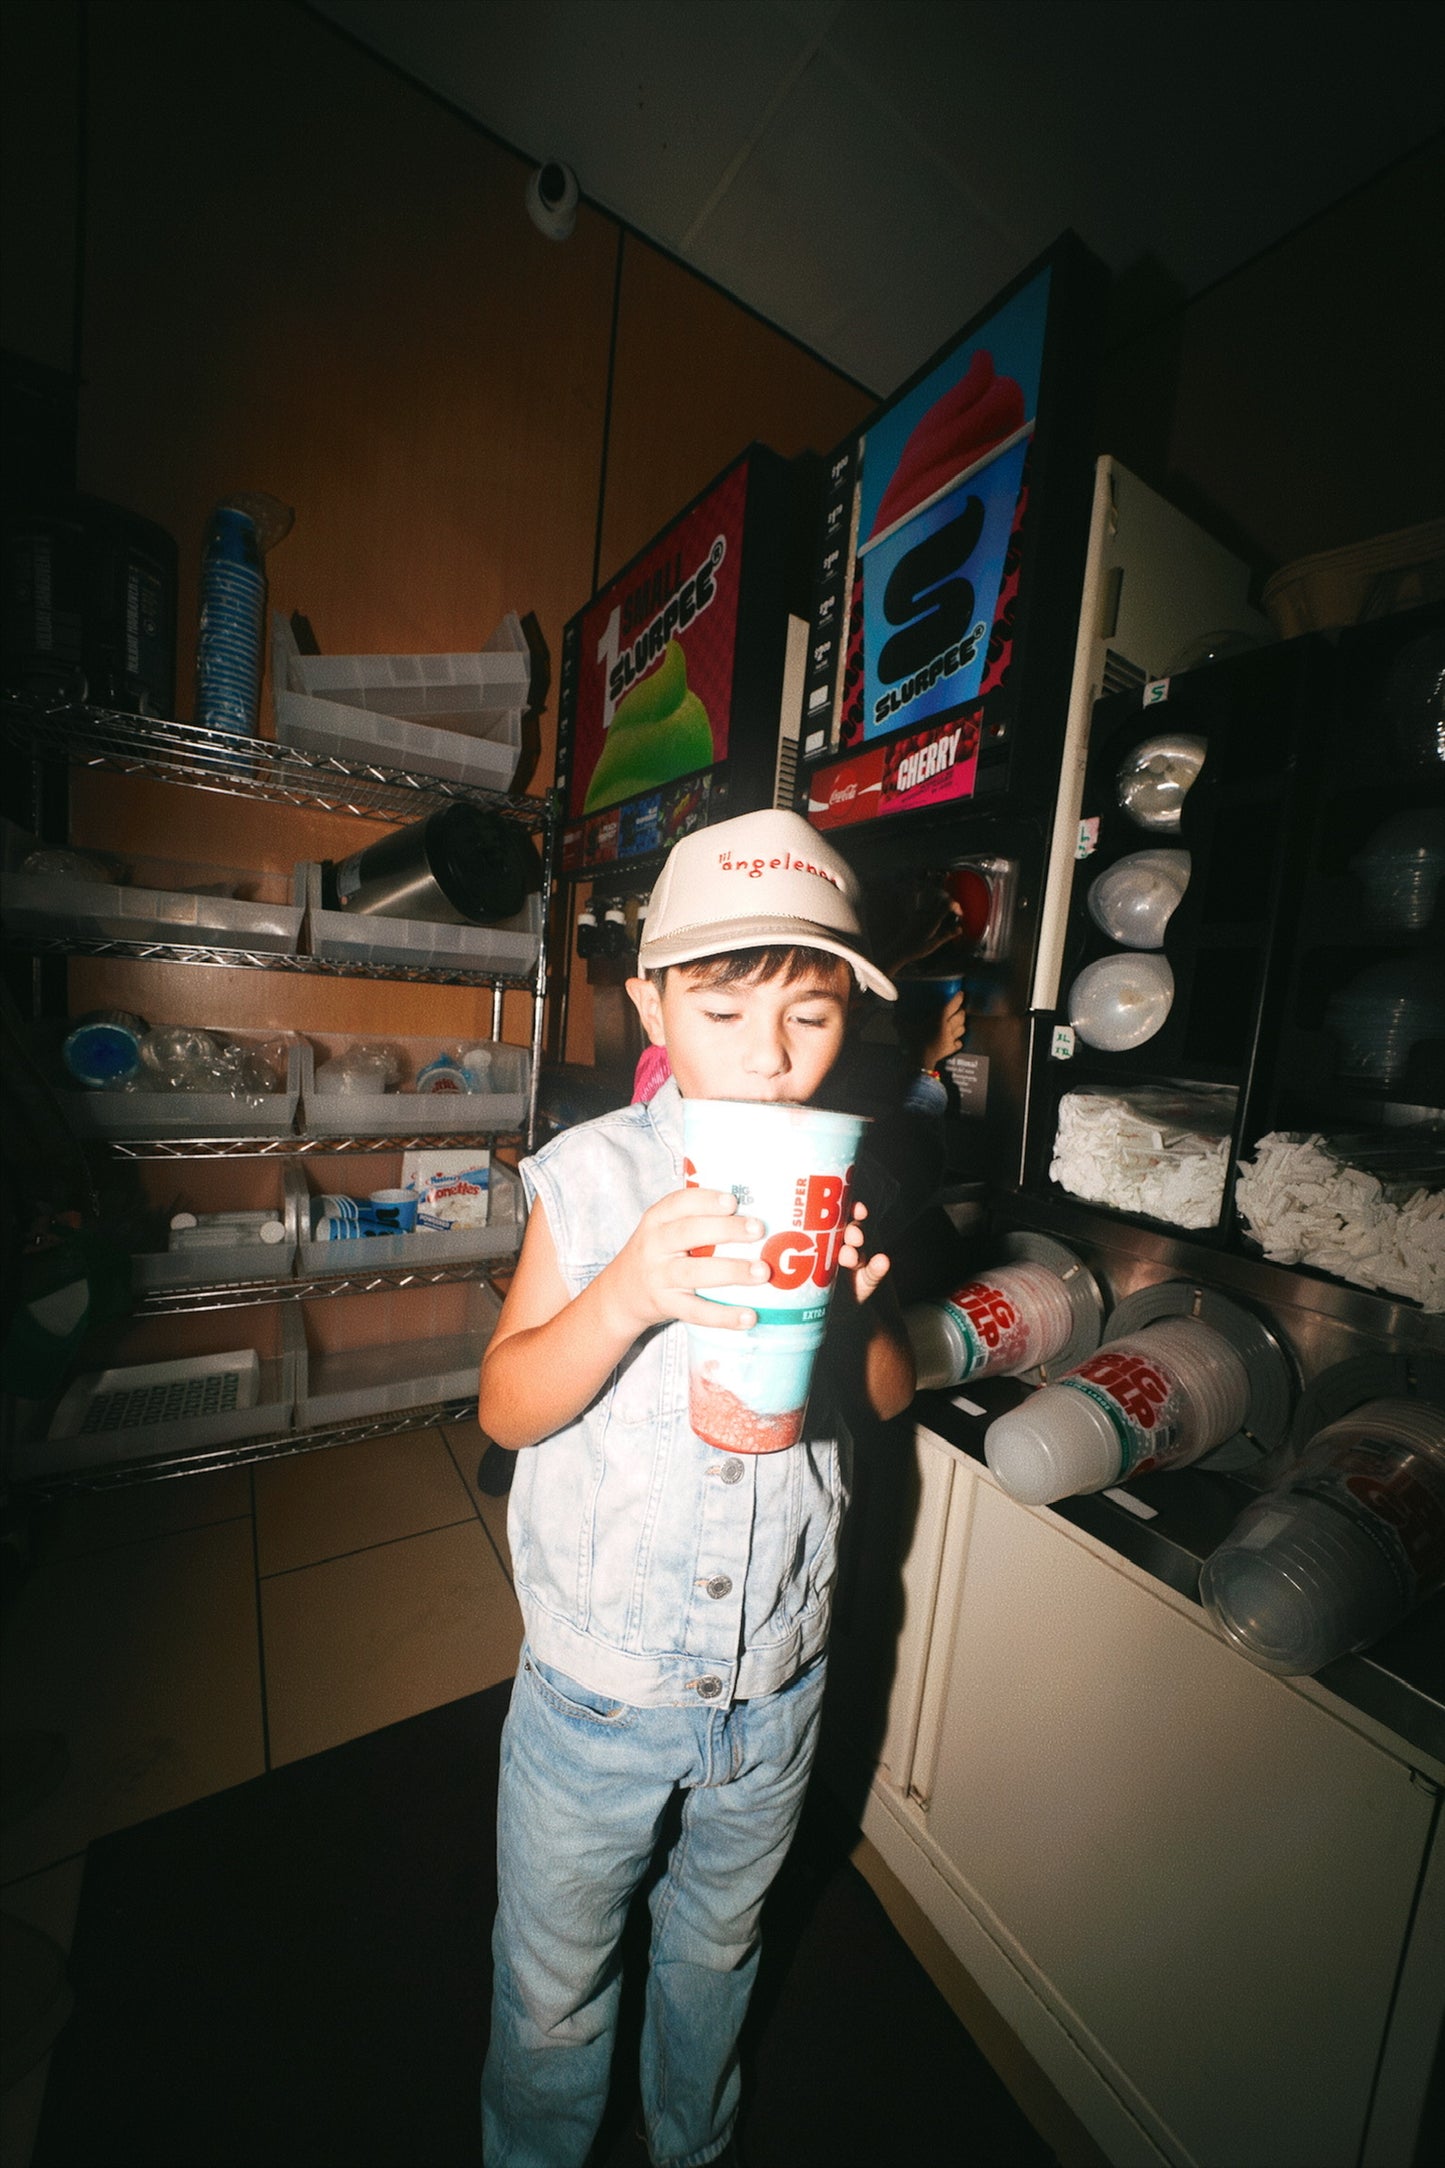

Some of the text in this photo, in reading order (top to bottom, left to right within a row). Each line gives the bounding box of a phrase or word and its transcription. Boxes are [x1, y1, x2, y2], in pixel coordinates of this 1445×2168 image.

[623, 552, 682, 635] SMALL
[896, 727, 962, 792] CHERRY
[792, 1177, 808, 1228] SUPER
[802, 1307, 826, 1321] EXTRA
